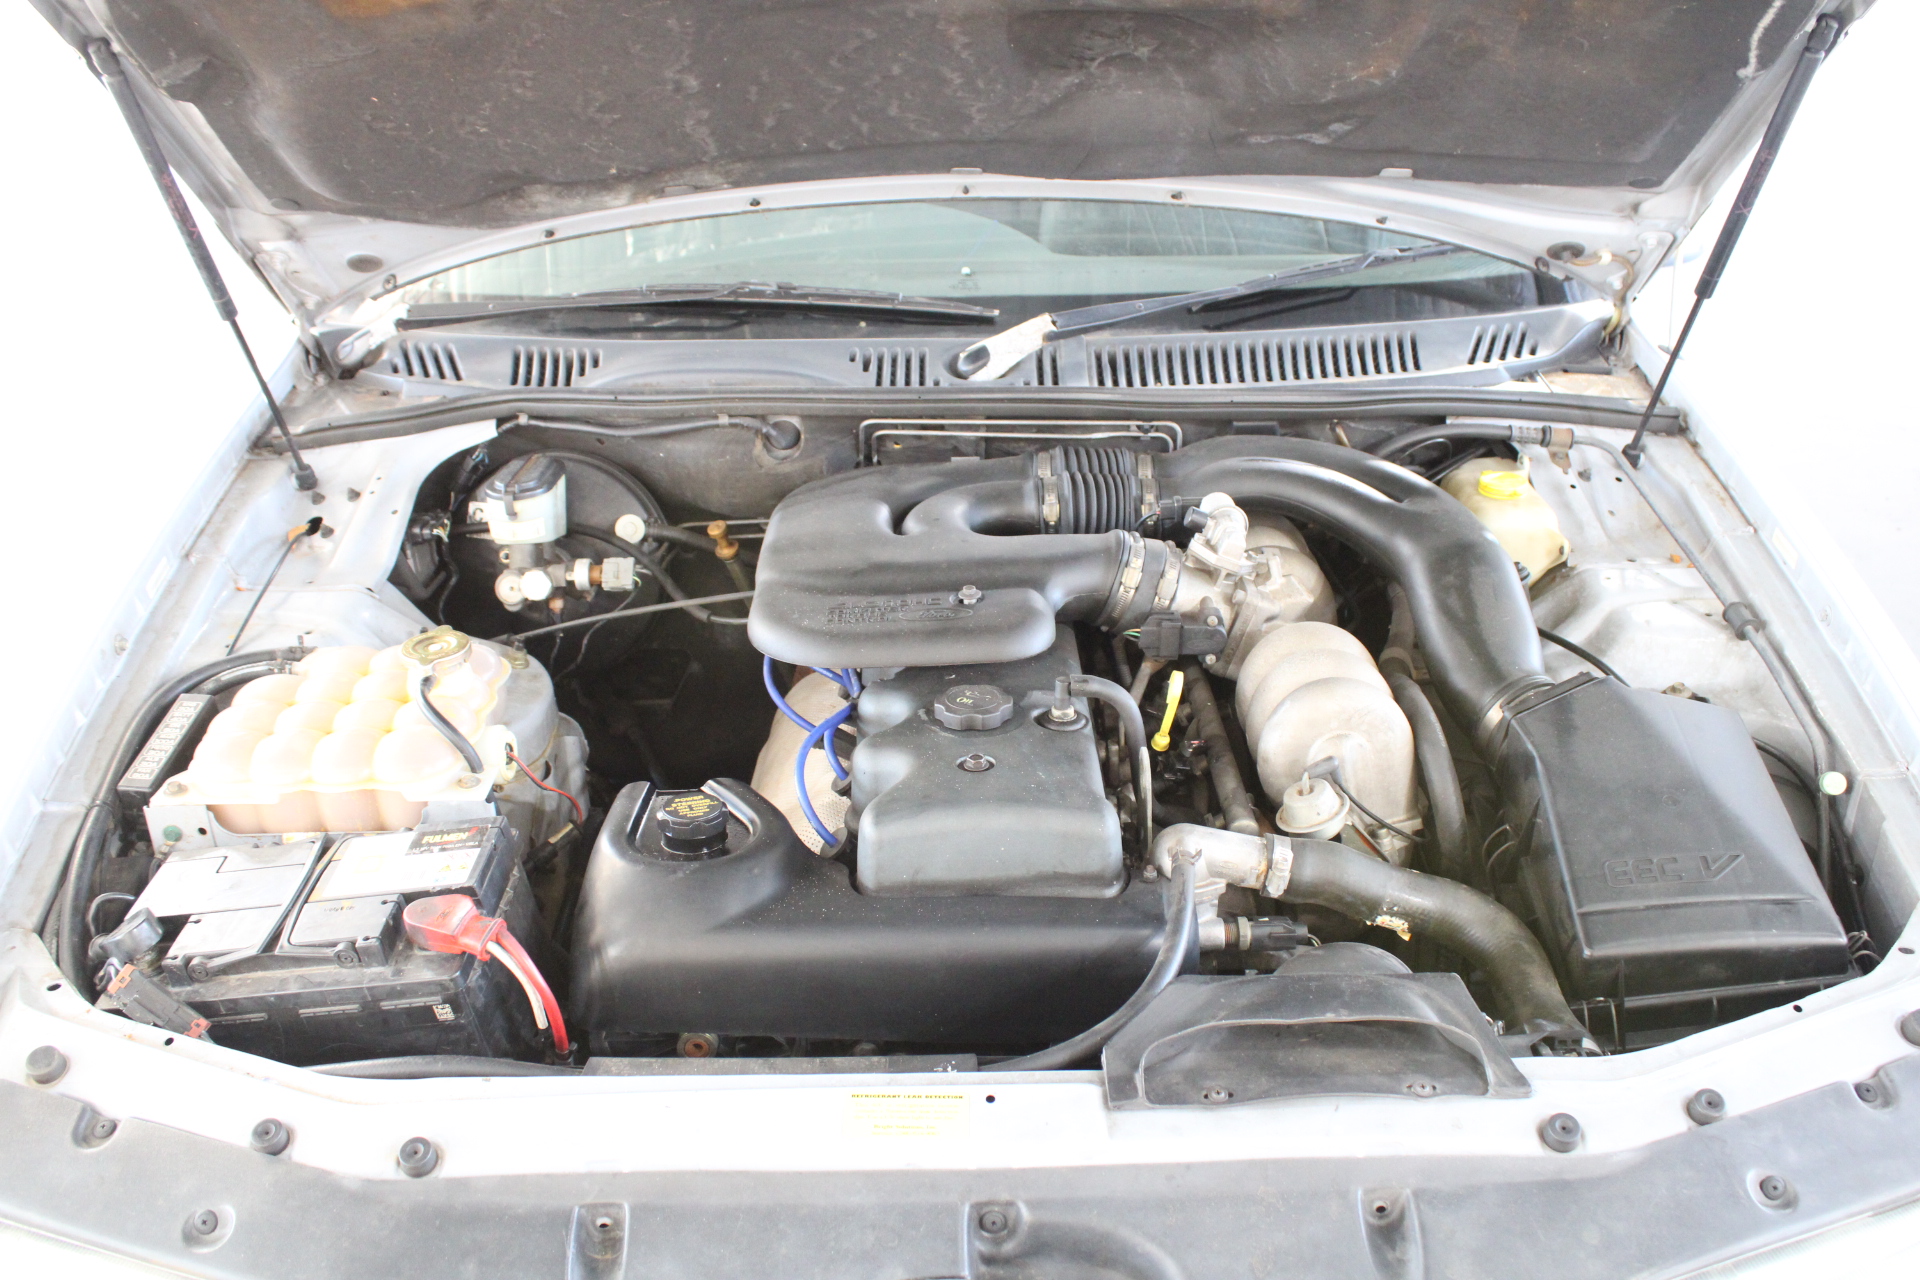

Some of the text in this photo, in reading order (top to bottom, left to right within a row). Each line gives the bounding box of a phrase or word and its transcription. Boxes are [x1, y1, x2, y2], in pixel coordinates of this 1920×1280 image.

[421, 832, 468, 844] FULMEN
[1605, 852, 1745, 887] EEC V
